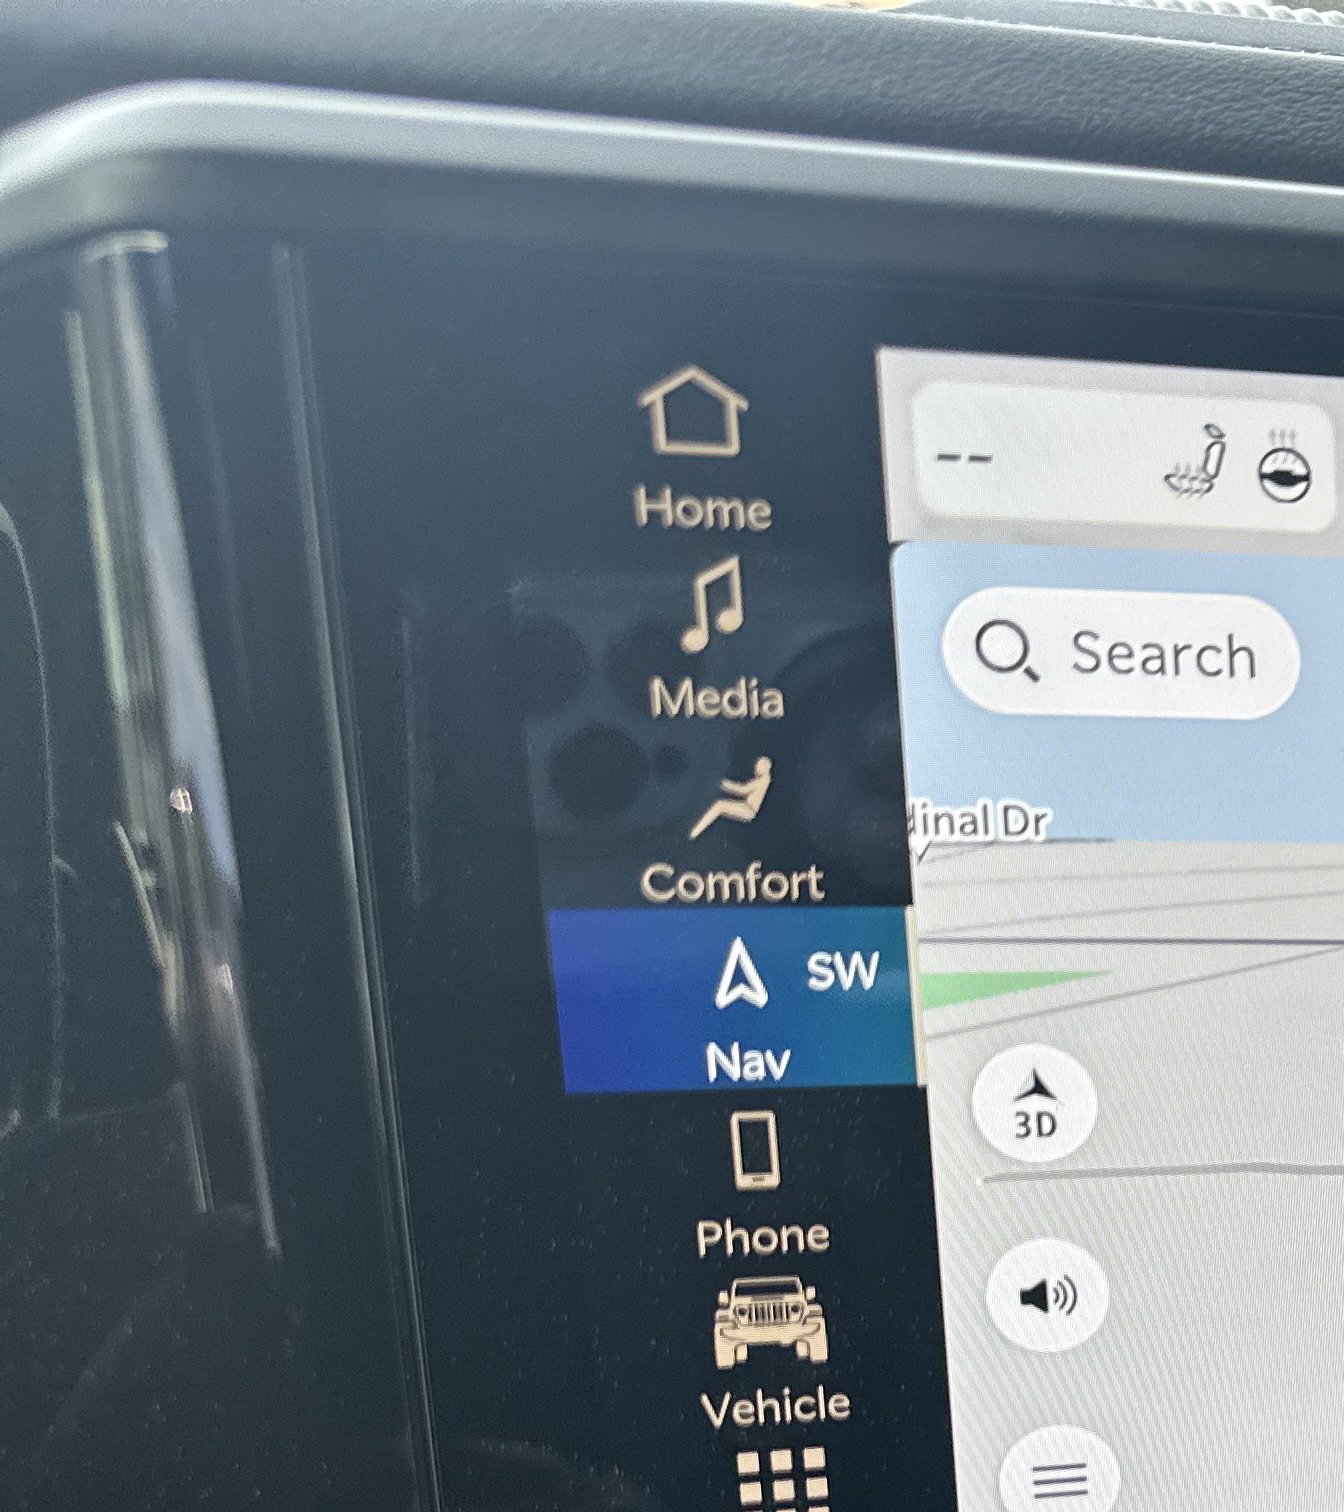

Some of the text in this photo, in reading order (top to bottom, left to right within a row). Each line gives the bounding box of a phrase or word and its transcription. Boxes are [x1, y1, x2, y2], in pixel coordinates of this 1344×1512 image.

[633, 484, 773, 531] Home
[1071, 631, 1257, 680] Search
[650, 677, 785, 720] Media
[1003, 804, 1047, 837] Dr
[641, 861, 825, 903] Comfort
[806, 953, 879, 992] SW
[706, 1042, 791, 1084] Nav
[1013, 1110, 1057, 1140] 3D
[697, 1218, 831, 1256] Phone
[702, 1386, 851, 1427] Vehicle
